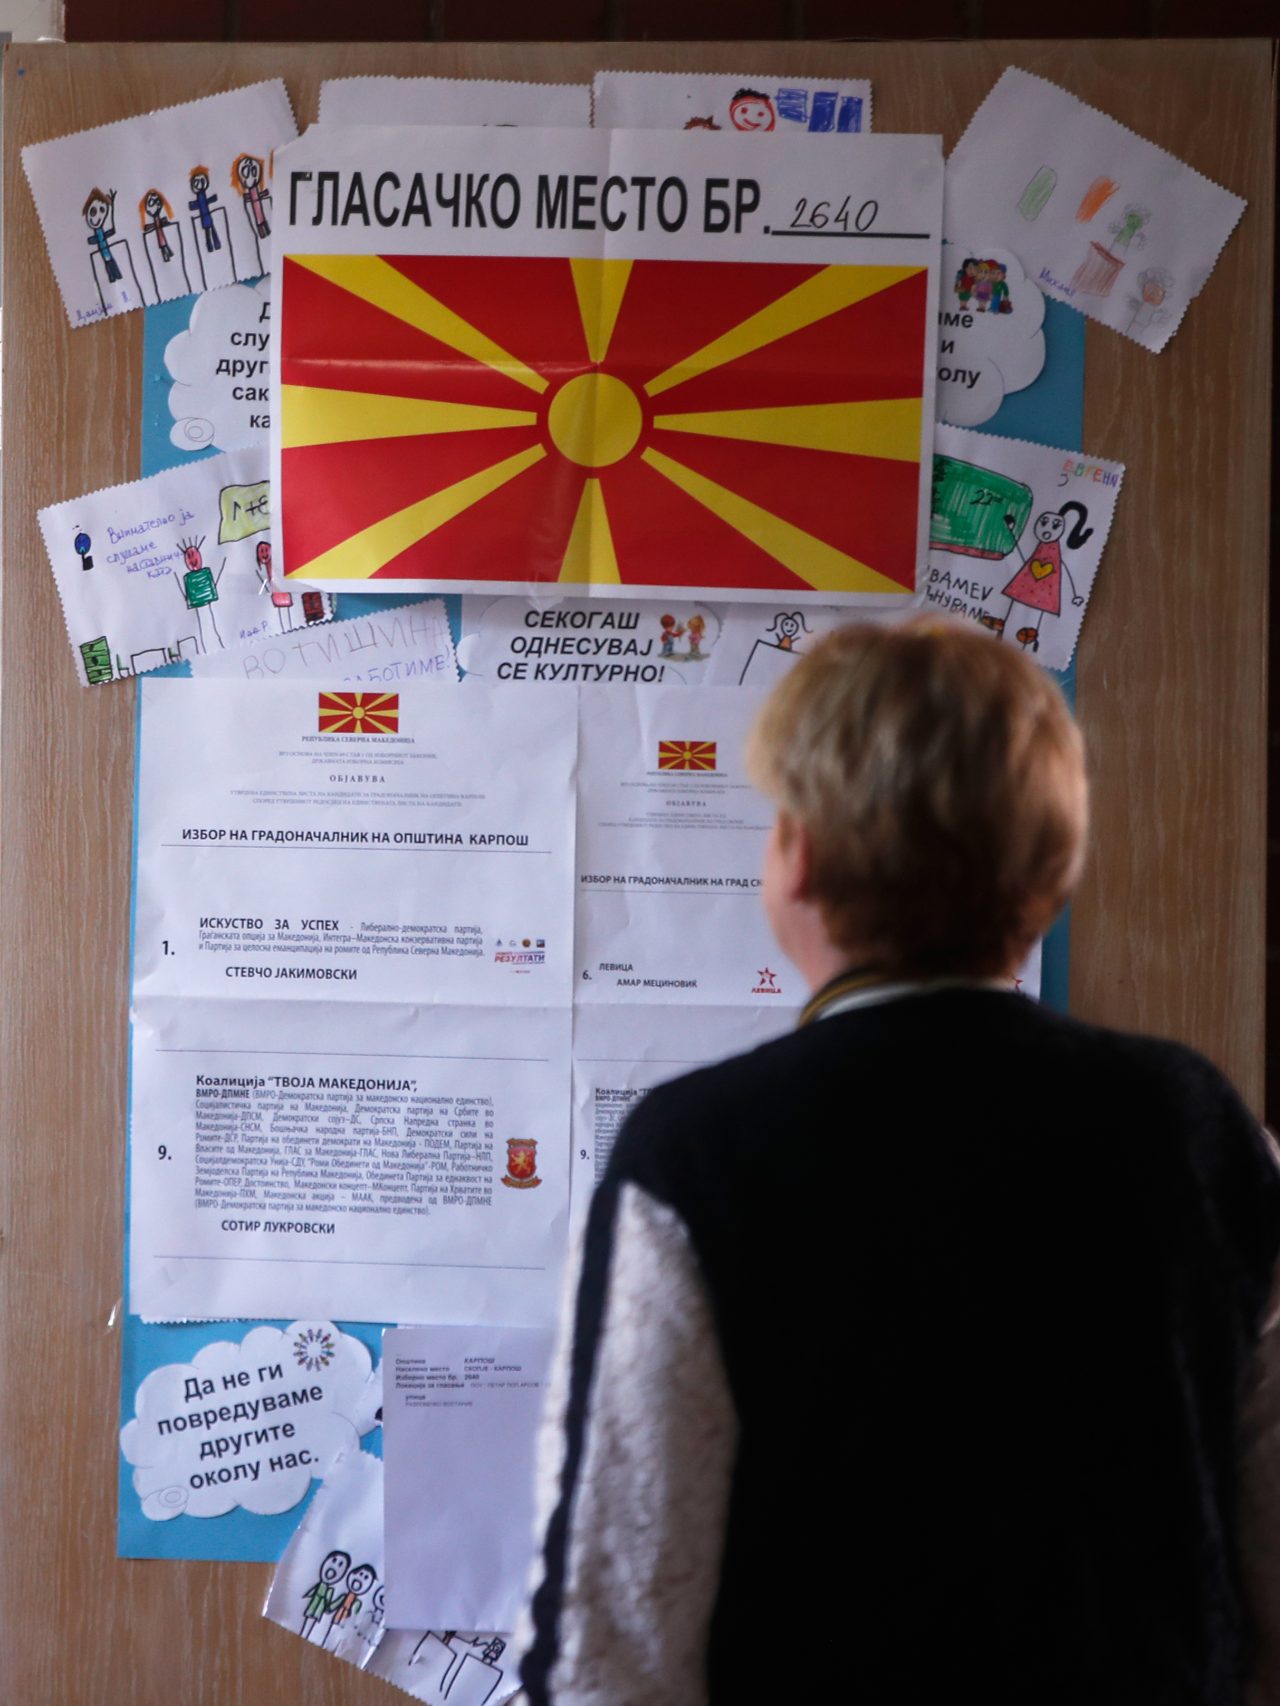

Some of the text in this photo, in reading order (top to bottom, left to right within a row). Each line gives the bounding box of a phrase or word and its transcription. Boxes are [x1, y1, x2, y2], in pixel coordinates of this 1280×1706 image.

[288, 171, 879, 235] ГЛАСАЧКО МЕСТО БР. 2640
[230, 331, 270, 352] слу
[216, 358, 269, 378] друг
[232, 386, 269, 401] сак
[524, 610, 640, 629] СЕКОГАШ
[510, 636, 653, 658] ОДНЕСУВАЈ
[497, 662, 665, 682] СЕ КУЛТУРНО!
[329, 774, 386, 783] ОБЈАВУВА
[182, 830, 529, 846] ИЗБОР НА ГРАДОНАЧАЛНИК НА ОПШТИНА КАРПОШ
[580, 875, 749, 888] ИЗБОР НА ГРАДОНАЧАЛНИК НА ГРАД
[199, 918, 264, 929] ИСКУСТВО
[274, 919, 290, 930] ЗА
[301, 920, 339, 931] УСПЕХ
[162, 940, 175, 955] 1.
[225, 967, 357, 980] СТЕВЧО ЈАКИМОВСКИ
[582, 970, 592, 980] 6.
[599, 963, 634, 972] ЛЕВИЦА
[617, 978, 641, 987] АМАР
[196, 1075, 266, 1088] Коалиција
[195, 1089, 250, 1100] ВМРО-ДПМНЕ
[158, 1145, 172, 1160] 9.
[580, 1149, 590, 1160] 9.
[220, 1220, 335, 1232] СОТИР ЛУКРОВСКИ
[184, 1364, 283, 1403] Да не ги
[157, 1385, 323, 1436] повредуваме
[199, 1422, 295, 1460] другите
[189, 1449, 319, 1489] околу нас.
